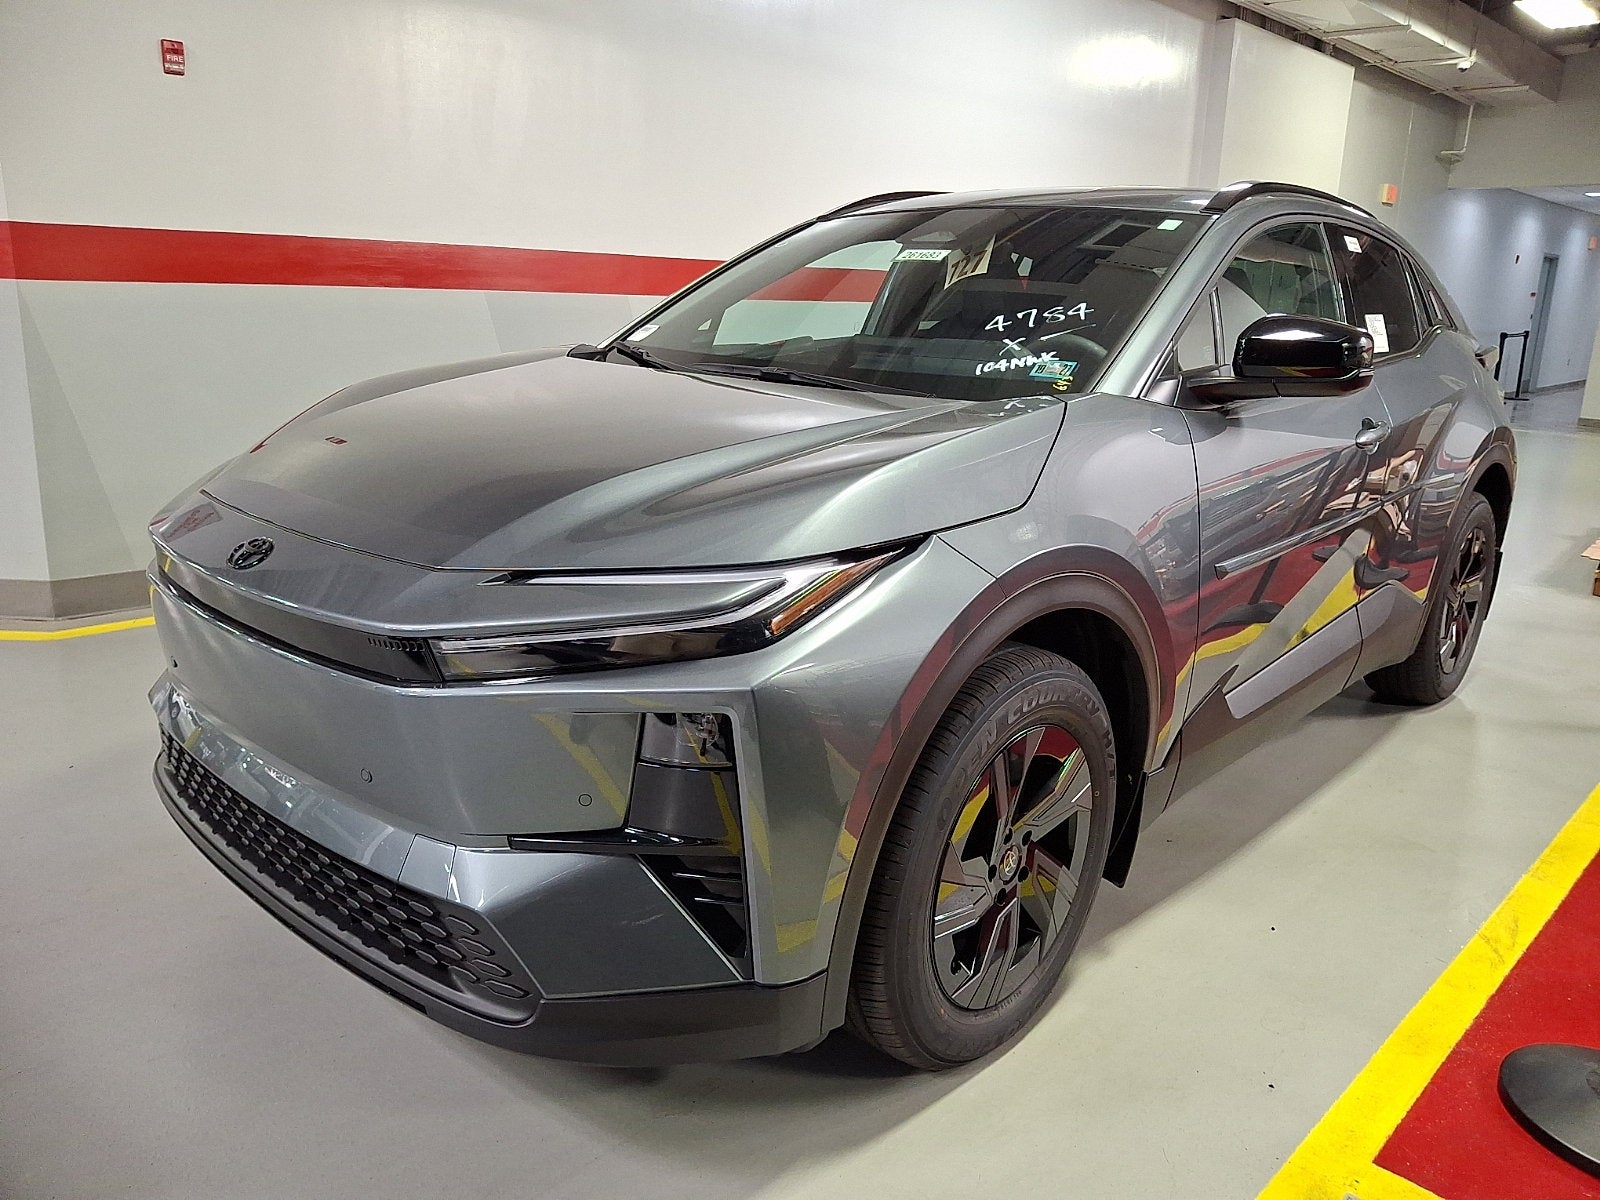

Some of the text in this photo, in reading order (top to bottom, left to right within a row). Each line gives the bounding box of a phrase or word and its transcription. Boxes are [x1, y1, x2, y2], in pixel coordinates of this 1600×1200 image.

[166, 54, 184, 63] FIRE
[984, 302, 1095, 332] 4784
[999, 337, 1026, 356] X
[1059, 363, 1073, 377] 27
